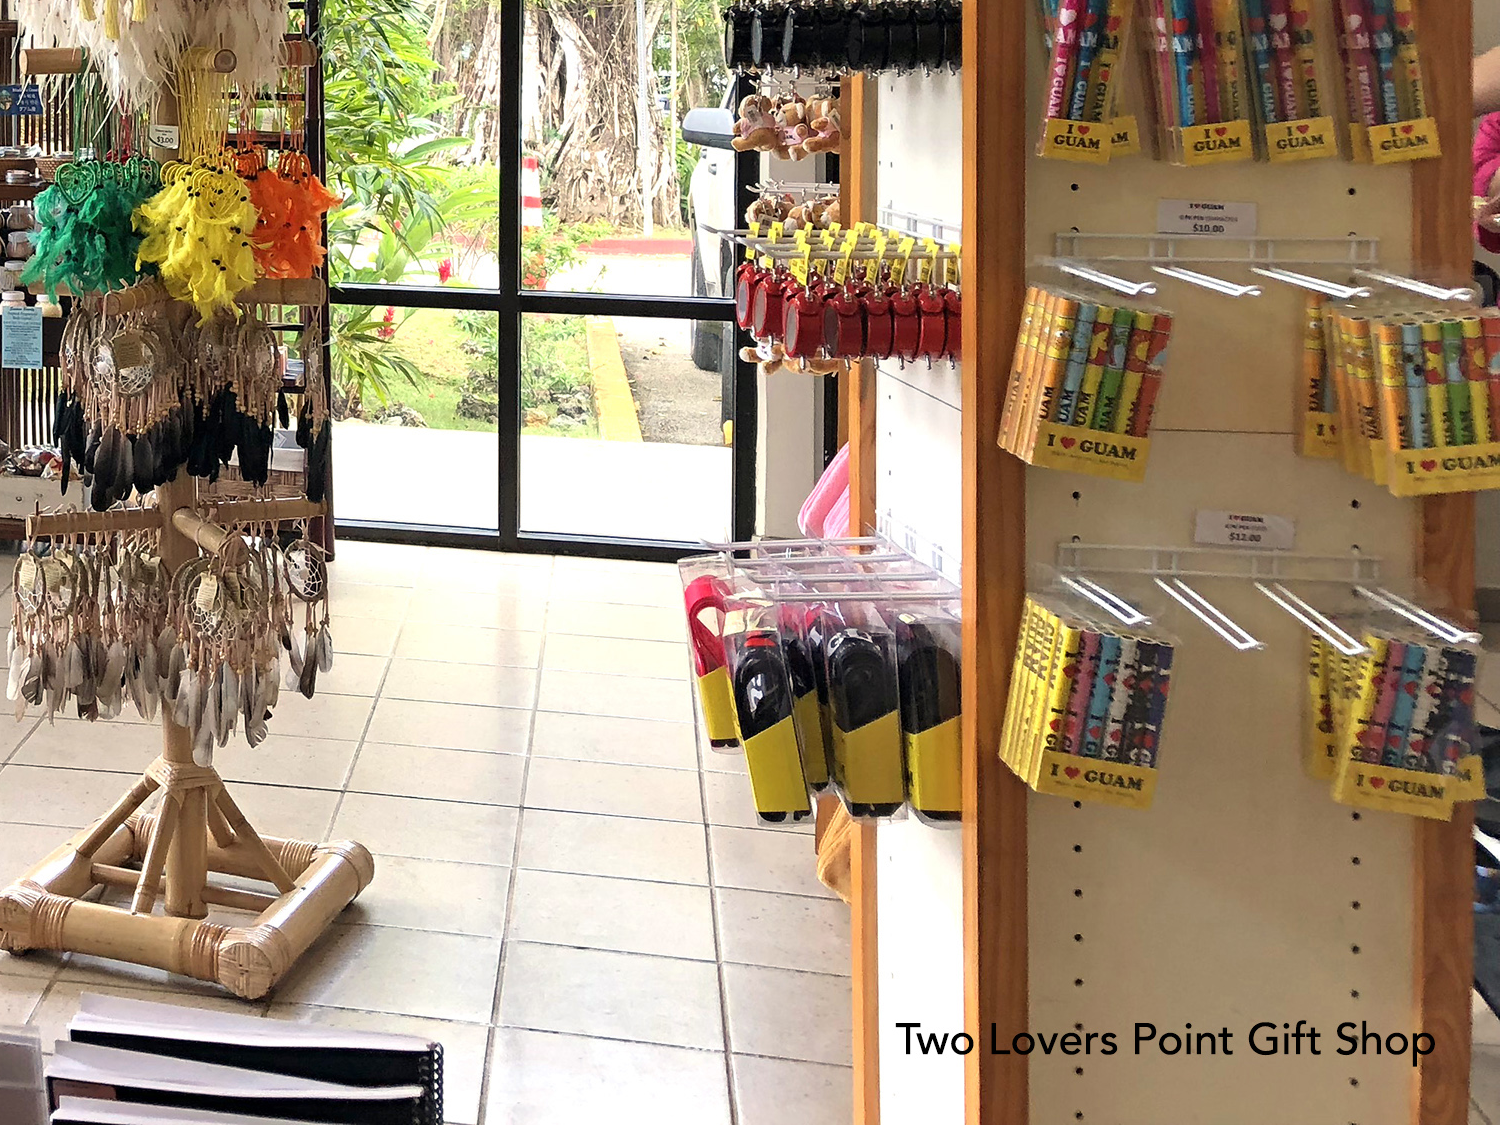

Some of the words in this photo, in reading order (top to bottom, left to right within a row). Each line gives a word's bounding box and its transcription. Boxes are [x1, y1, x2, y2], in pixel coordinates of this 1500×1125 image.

[157, 136, 174, 144] $3.00
[1054, 135, 1100, 150] GUAM
[1194, 137, 1240, 152] GUAM
[1276, 134, 1324, 150] GUAM
[1380, 135, 1429, 151] GUAM
[1040, 386, 1055, 419] UAM
[1059, 389, 1074, 423] UAM
[1309, 378, 1320, 412] UAM
[1075, 391, 1094, 426] UAM
[1099, 395, 1115, 430] UAM
[1047, 434, 1055, 447] I
[1080, 440, 1137, 460] GUAM
[1051, 763, 1059, 776] I
[1084, 770, 1144, 791] GUAM
[1388, 780, 1445, 799] GUAM
